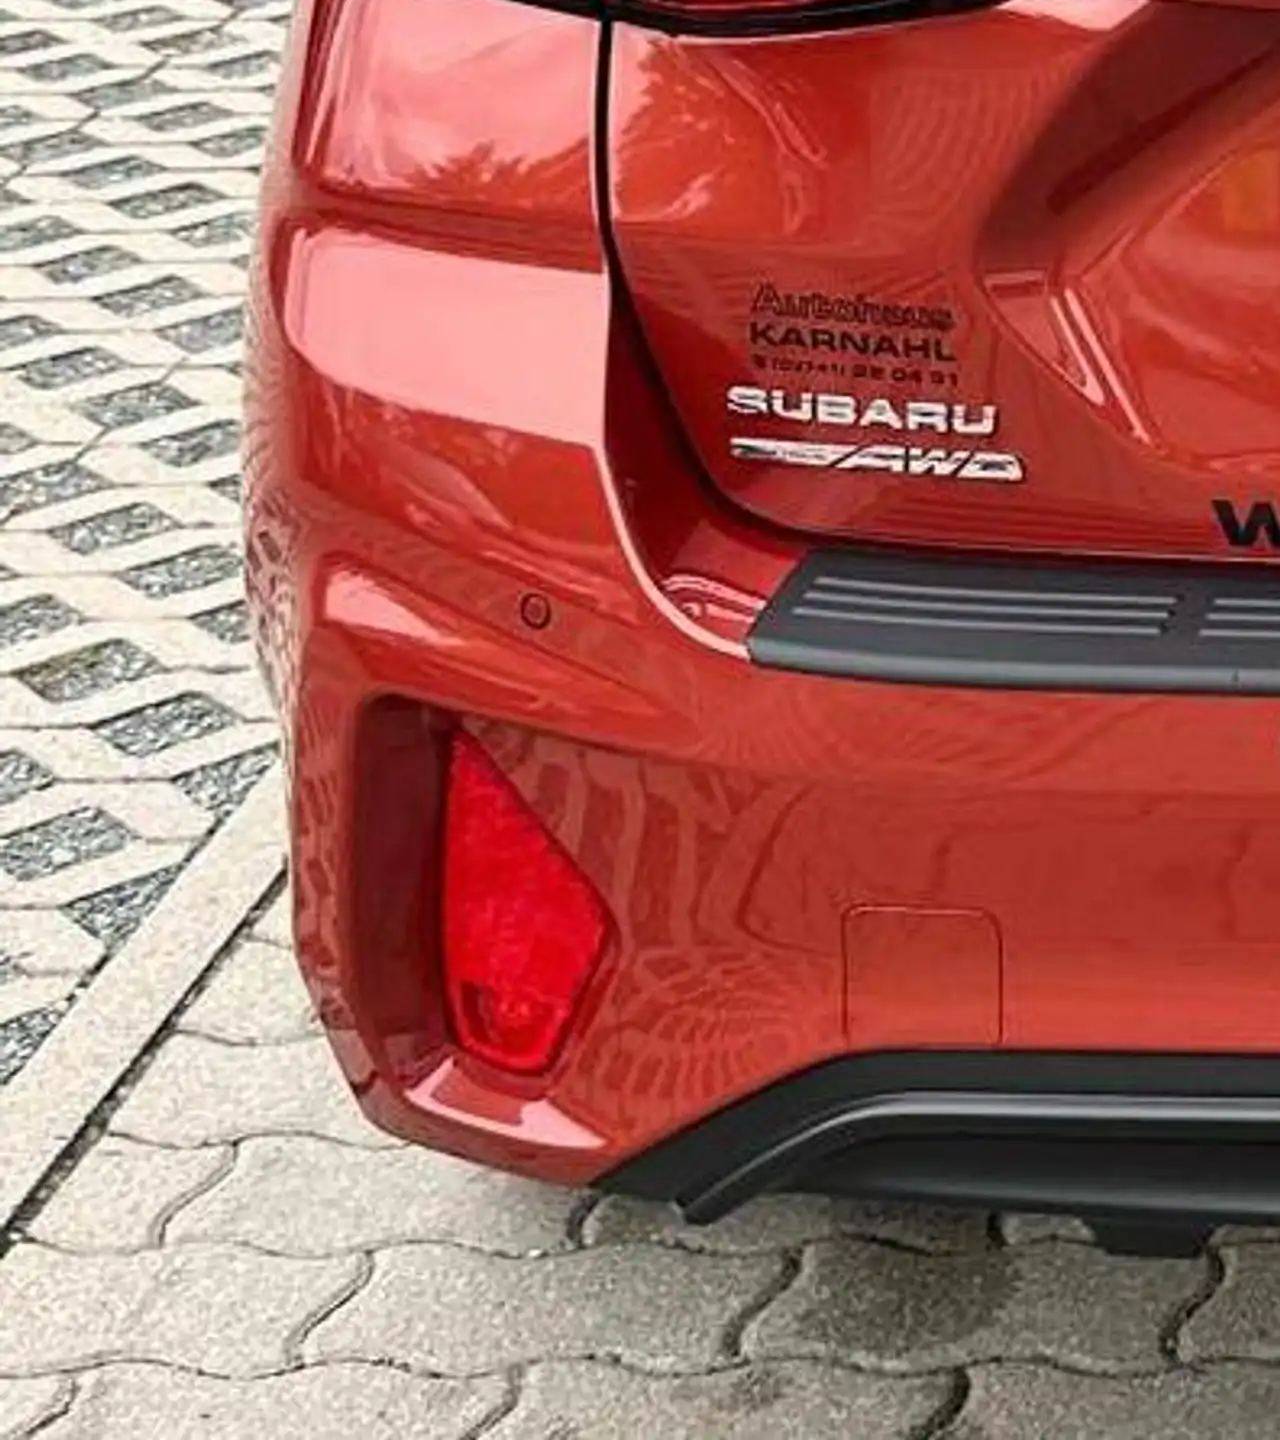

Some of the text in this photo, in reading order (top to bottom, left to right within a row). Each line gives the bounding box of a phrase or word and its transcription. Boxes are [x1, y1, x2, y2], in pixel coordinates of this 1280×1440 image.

[752, 286, 956, 330] Autohaus
[750, 322, 957, 361] KARNAHL
[726, 385, 997, 435] SUBARU
[835, 444, 1023, 481] AWD
